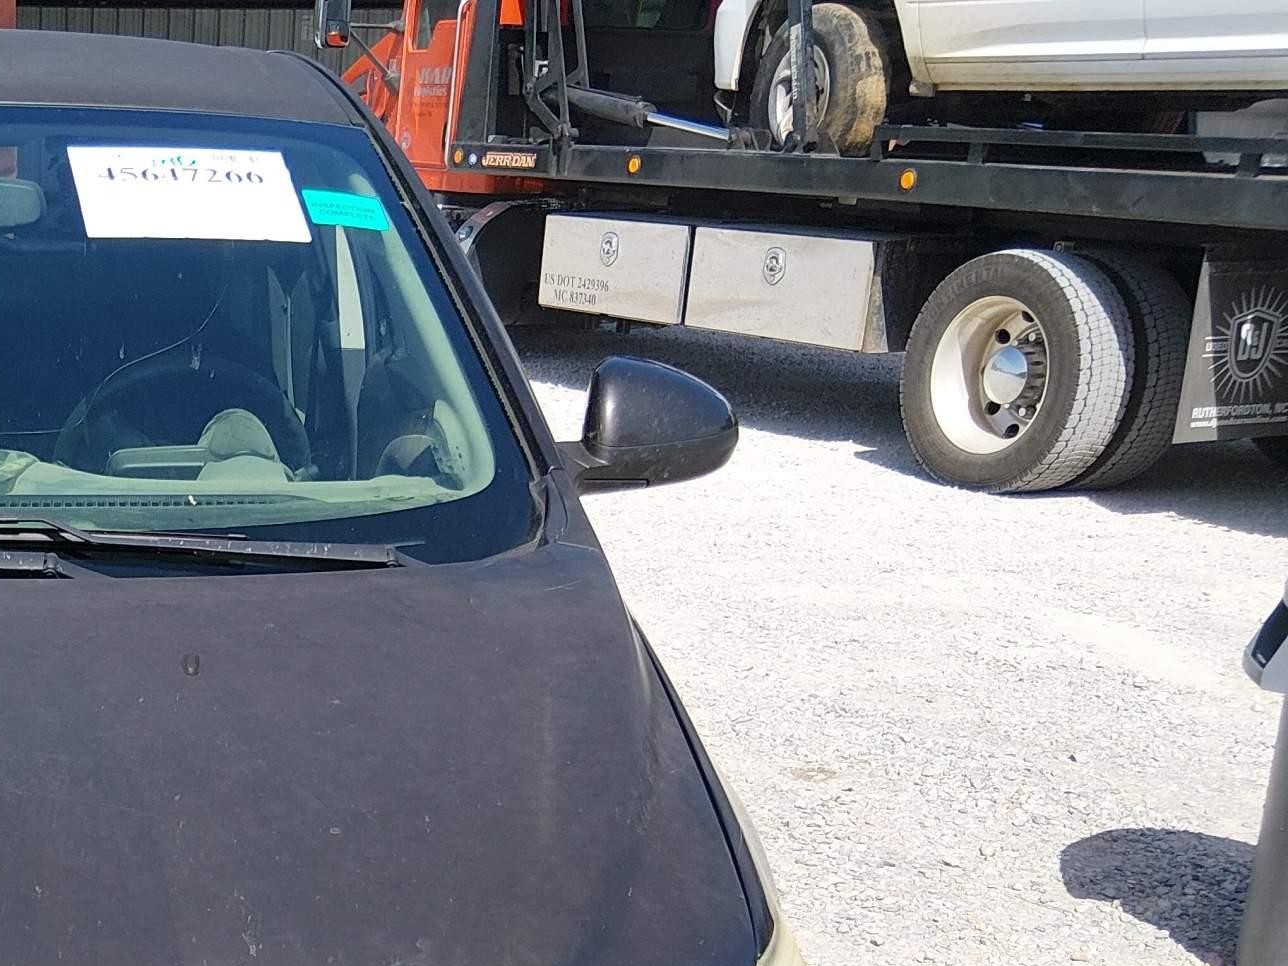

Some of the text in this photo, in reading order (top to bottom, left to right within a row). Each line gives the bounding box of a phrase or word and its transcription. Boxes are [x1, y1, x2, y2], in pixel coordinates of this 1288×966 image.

[312, 202, 375, 214] INSPECTION
[319, 209, 375, 220] COMPLETE
[544, 273, 609, 292] US DOT 2429396
[554, 288, 597, 305] MC 837340
